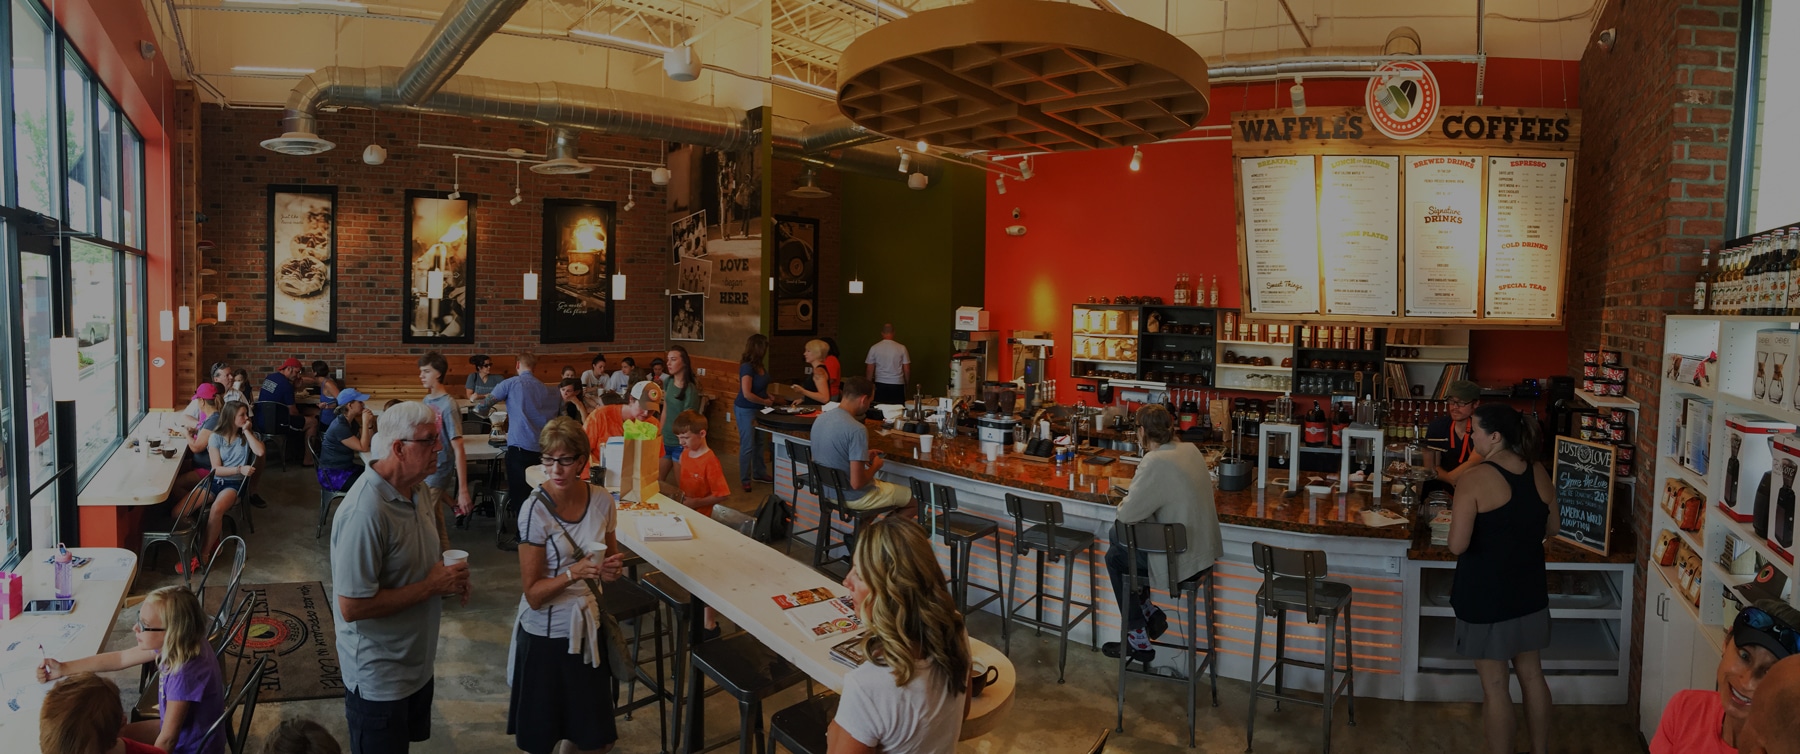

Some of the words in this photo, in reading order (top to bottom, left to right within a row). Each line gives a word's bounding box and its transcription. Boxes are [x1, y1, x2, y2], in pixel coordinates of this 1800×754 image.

[1239, 116, 1364, 142] WAFFLES
[1442, 115, 1570, 143] COFFEES
[1257, 158, 1298, 168] BREAKFAST
[1331, 158, 1356, 169] LUNCH
[1363, 158, 1390, 170] DINNER
[1414, 158, 1445, 168] BREWED
[1447, 158, 1474, 169] DRINKS
[1510, 160, 1546, 168] ESPRESSO
[1428, 205, 1461, 215] Signature
[1424, 216, 1463, 224] DRINKS
[1362, 231, 1388, 240] PLATES
[1522, 242, 1548, 250] DRINKS
[720, 258, 749, 272] LOVE
[1266, 281, 1283, 289] Sweet
[1284, 280, 1303, 291] Things
[720, 292, 748, 304] HERE
[1559, 441, 1578, 456] JUST
[1590, 450, 1612, 467] LOVE
[1559, 472, 1582, 489] Share
[1583, 474, 1593, 488] the
[1594, 475, 1608, 489] Love
[1562, 518, 1590, 532] ADOPTION
[242, 588, 270, 617] JUST
[303, 597, 315, 609] ARE
[285, 619, 300, 642] COFFEE
[315, 648, 329, 656] IN
[253, 649, 281, 693] LOVE
[318, 658, 344, 690] LOVE!
